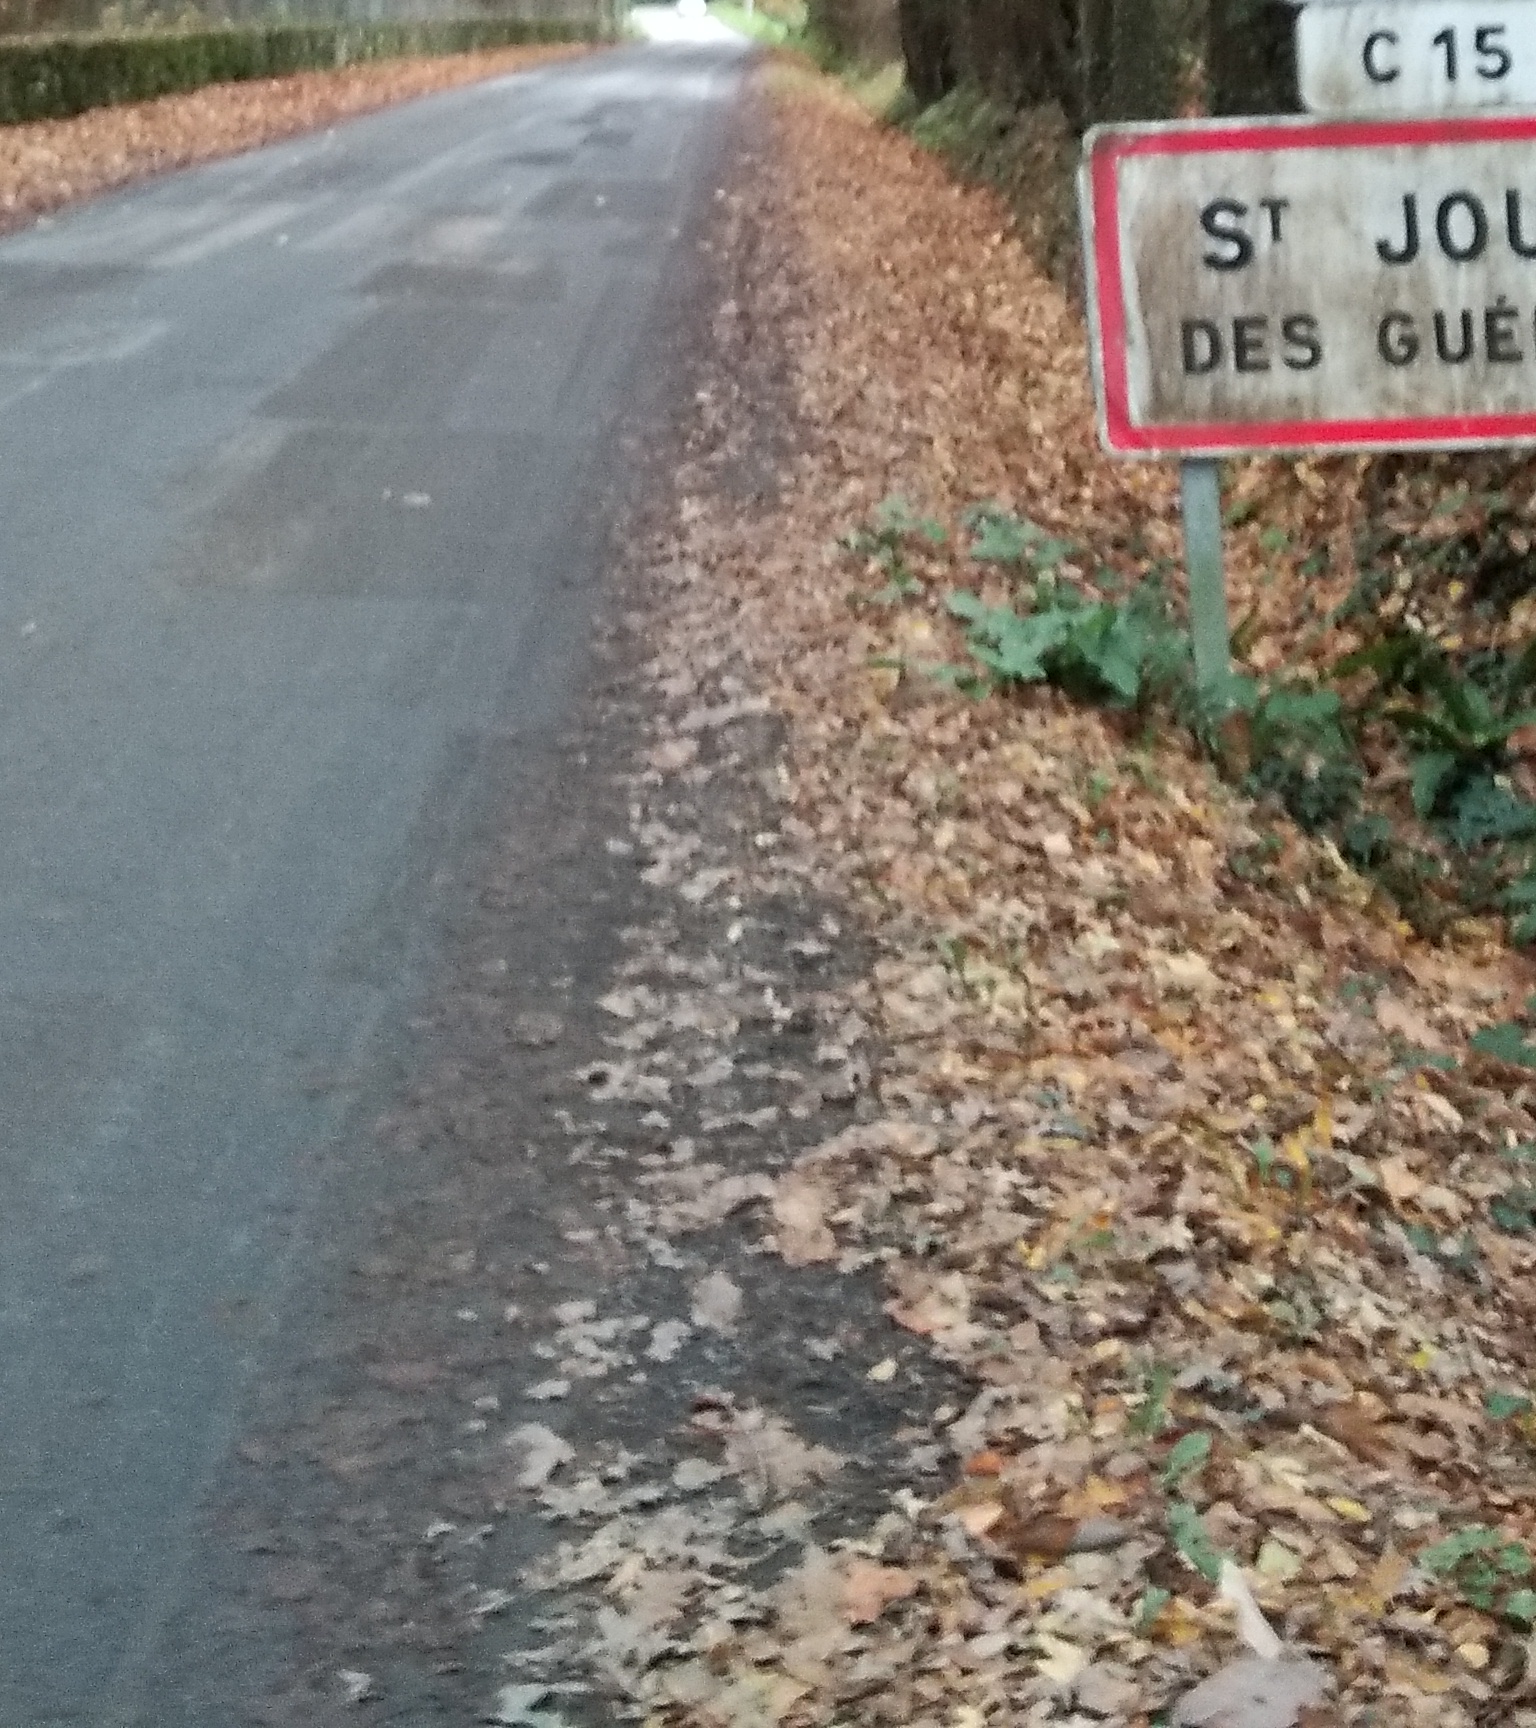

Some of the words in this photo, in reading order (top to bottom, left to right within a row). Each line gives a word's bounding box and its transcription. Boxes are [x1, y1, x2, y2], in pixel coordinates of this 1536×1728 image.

[1362, 29, 1401, 83] C
[1432, 24, 1512, 80] 15
[1180, 313, 1322, 374] DES
